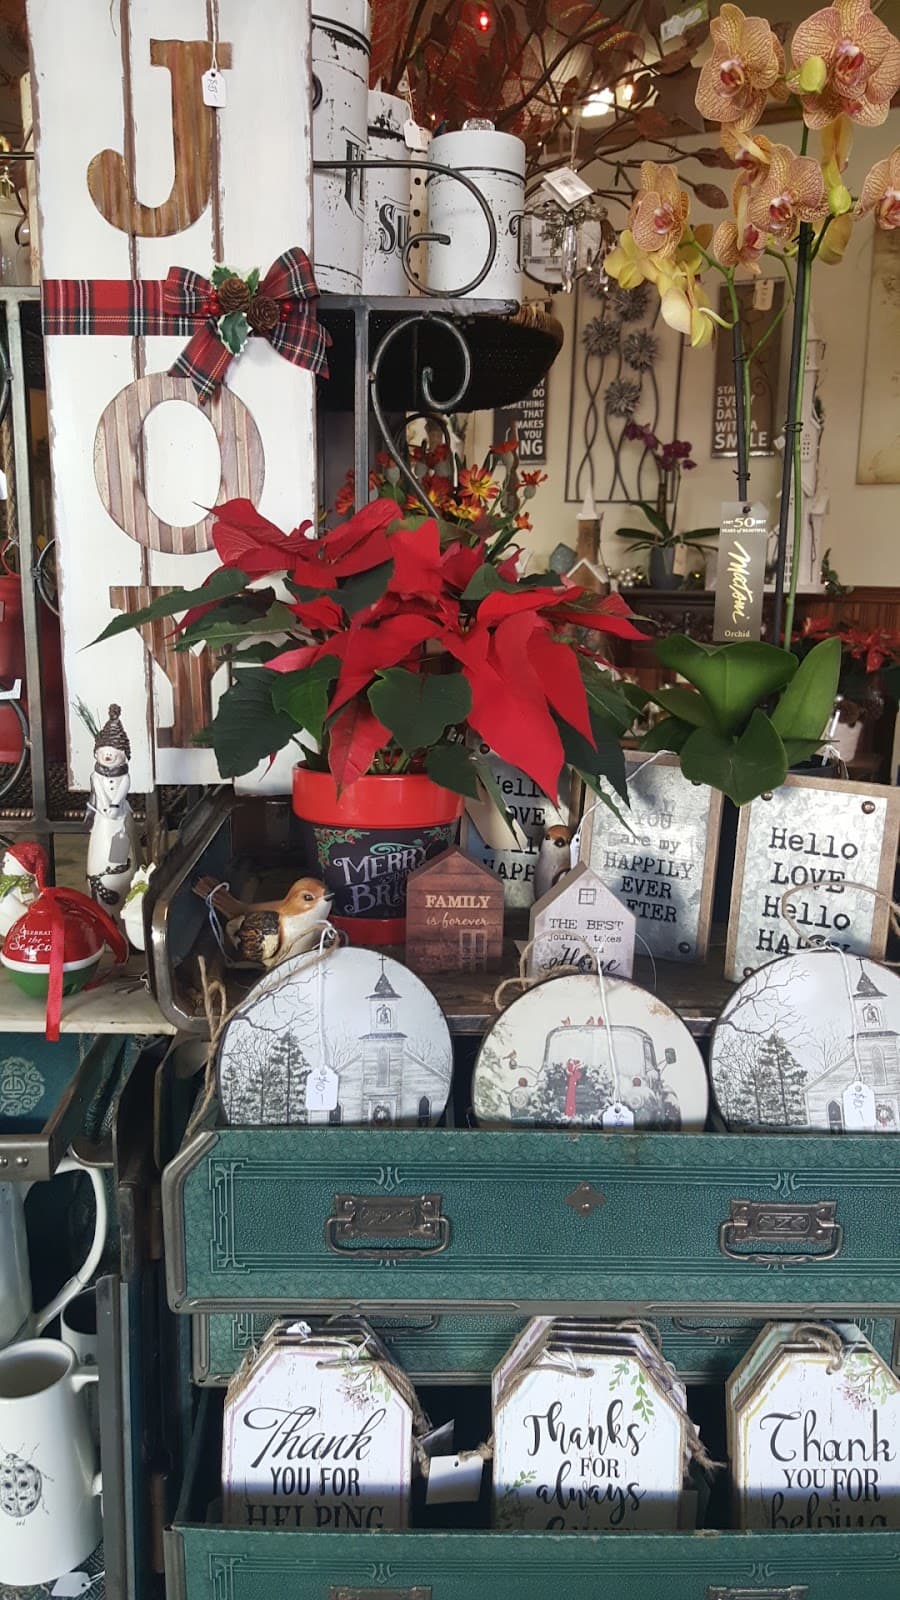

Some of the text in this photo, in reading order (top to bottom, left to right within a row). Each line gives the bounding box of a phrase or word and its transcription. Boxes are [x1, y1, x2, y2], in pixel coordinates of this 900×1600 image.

[532, 388, 545, 397] DO
[522, 409, 545, 419] THAT
[523, 430, 542, 439] YOU
[714, 431, 767, 450] SMLE
[733, 517, 756, 528] 50
[724, 629, 751, 638] Orchid
[658, 838, 682, 854] my
[768, 826, 859, 860] Hello
[602, 850, 695, 881] HAPPILY
[769, 861, 846, 894] LOVE
[620, 875, 672, 900] EVER
[424, 894, 491, 909] FAMILY
[625, 898, 678, 923] FTER
[761, 894, 851, 931] Hello
[426, 916, 438, 927] is
[549, 918, 624, 931] THE BEST
[243, 1405, 387, 1469] Thank
[523, 1399, 647, 1457] Thanks
[759, 1408, 897, 1463] Thank
[579, 1457, 620, 1479] FOR
[270, 1466, 361, 1497] YOU FOR
[535, 1460, 647, 1525] always
[781, 1467, 881, 1502] YOU FOR
